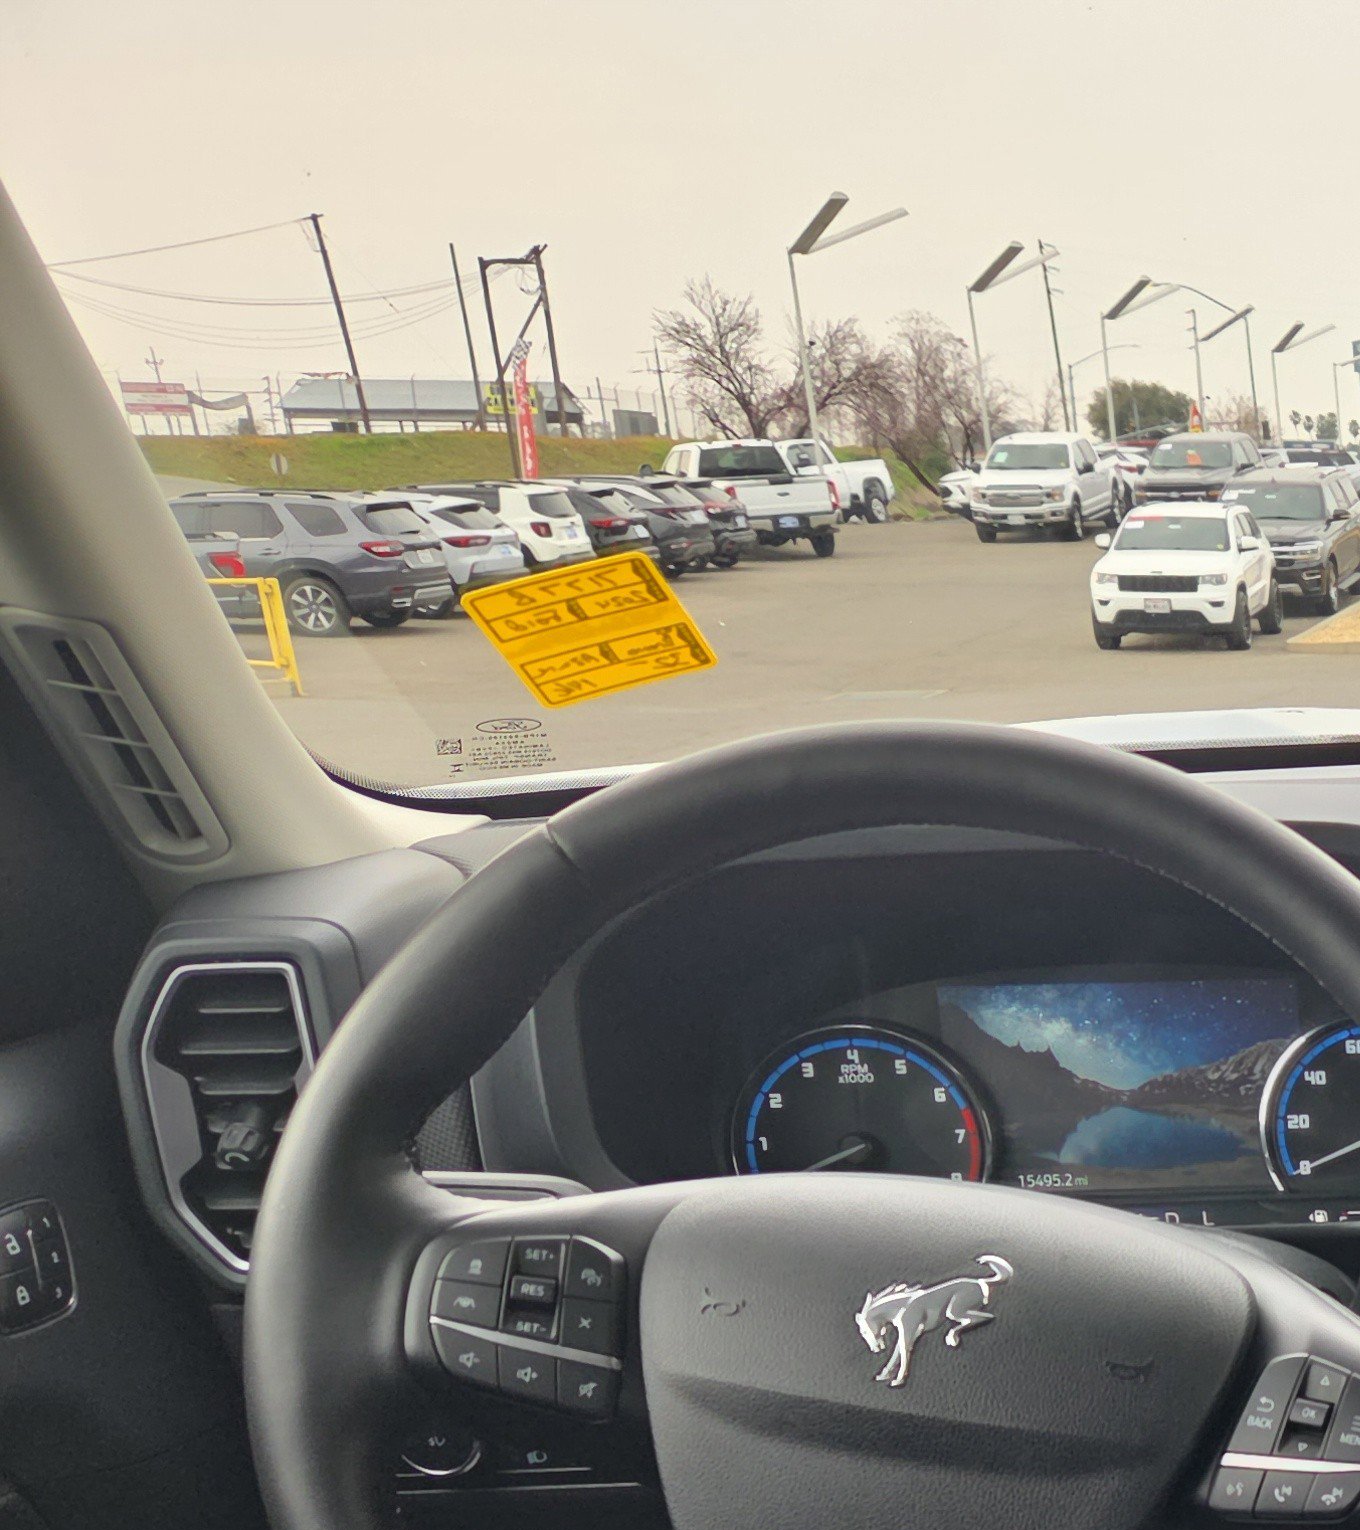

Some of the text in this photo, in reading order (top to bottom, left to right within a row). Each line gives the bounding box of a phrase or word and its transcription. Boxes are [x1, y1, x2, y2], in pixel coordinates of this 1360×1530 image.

[847, 1049, 859, 1063] 4
[801, 1062, 814, 1077] 3
[840, 1063, 868, 1074] RPM
[894, 1059, 907, 1074] 5
[1304, 1070, 1327, 1085] 40
[768, 1093, 782, 1109] 2
[933, 1087, 946, 1102] 6
[1287, 1114, 1309, 1129] 20
[955, 1128, 966, 1143] 7
[758, 1136, 768, 1151] 1
[1018, 1173, 1088, 1188] 15495.2 mi
[1202, 1211, 1215, 1226] L
[520, 1283, 545, 1297] RES
[1302, 1407, 1318, 1419] OK
[1246, 1415, 1273, 1429] BACK
